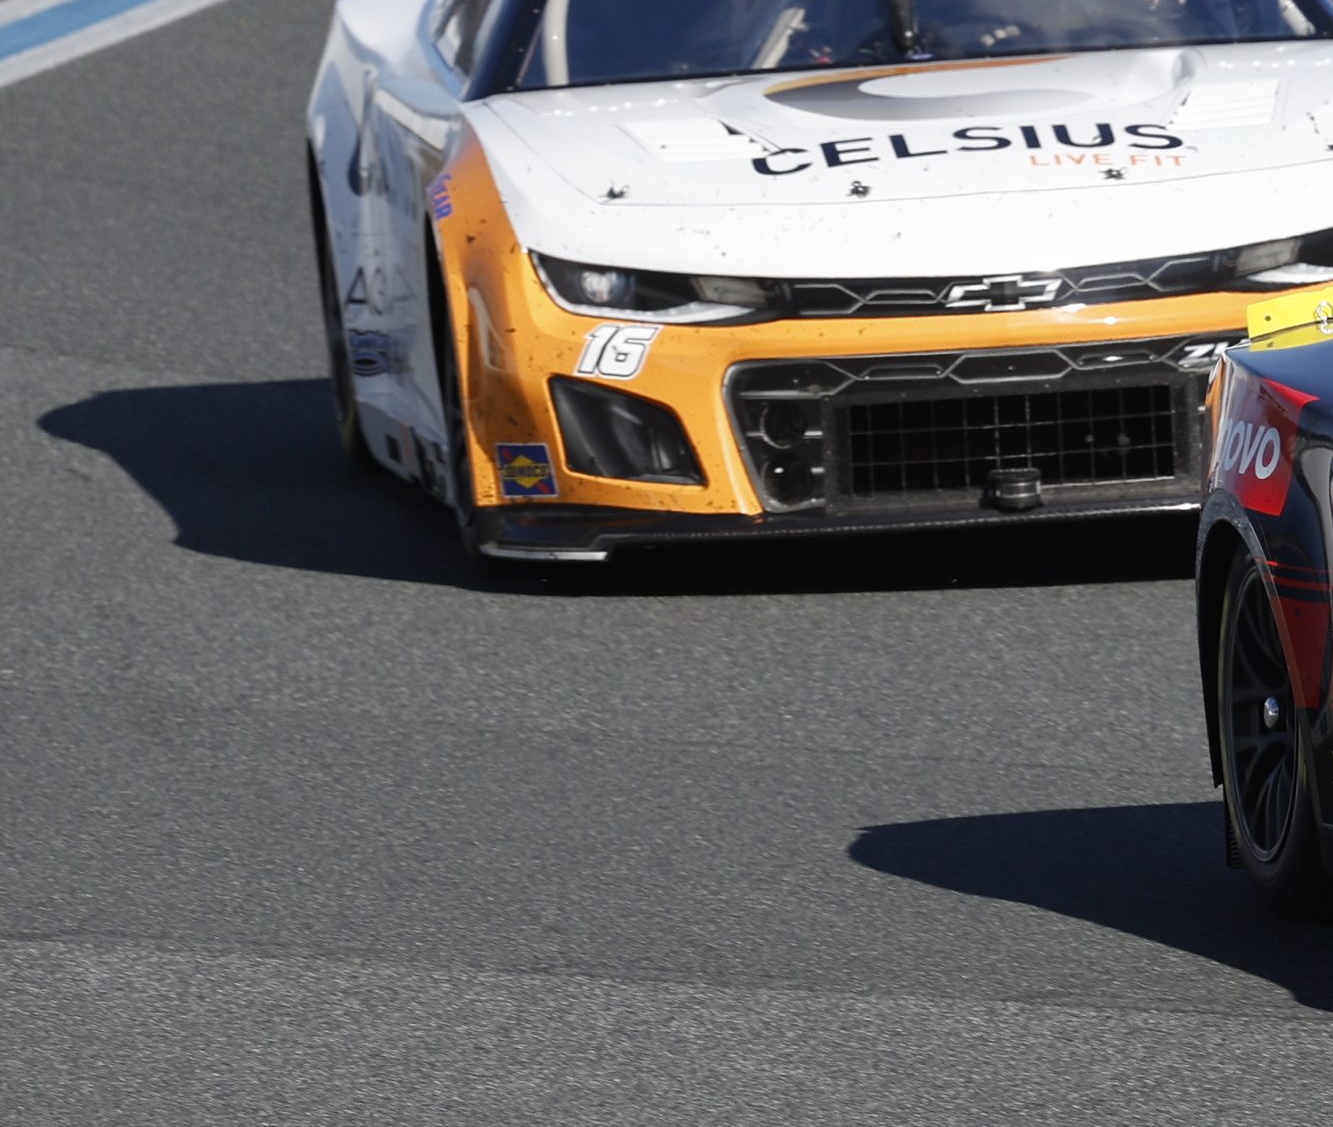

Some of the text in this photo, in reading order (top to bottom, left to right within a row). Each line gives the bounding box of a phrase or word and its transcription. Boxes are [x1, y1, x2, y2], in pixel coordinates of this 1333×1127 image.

[751, 122, 1186, 176] CELSIUS
[1029, 153, 1187, 167] LIVE FIT
[574, 323, 664, 380] 16
